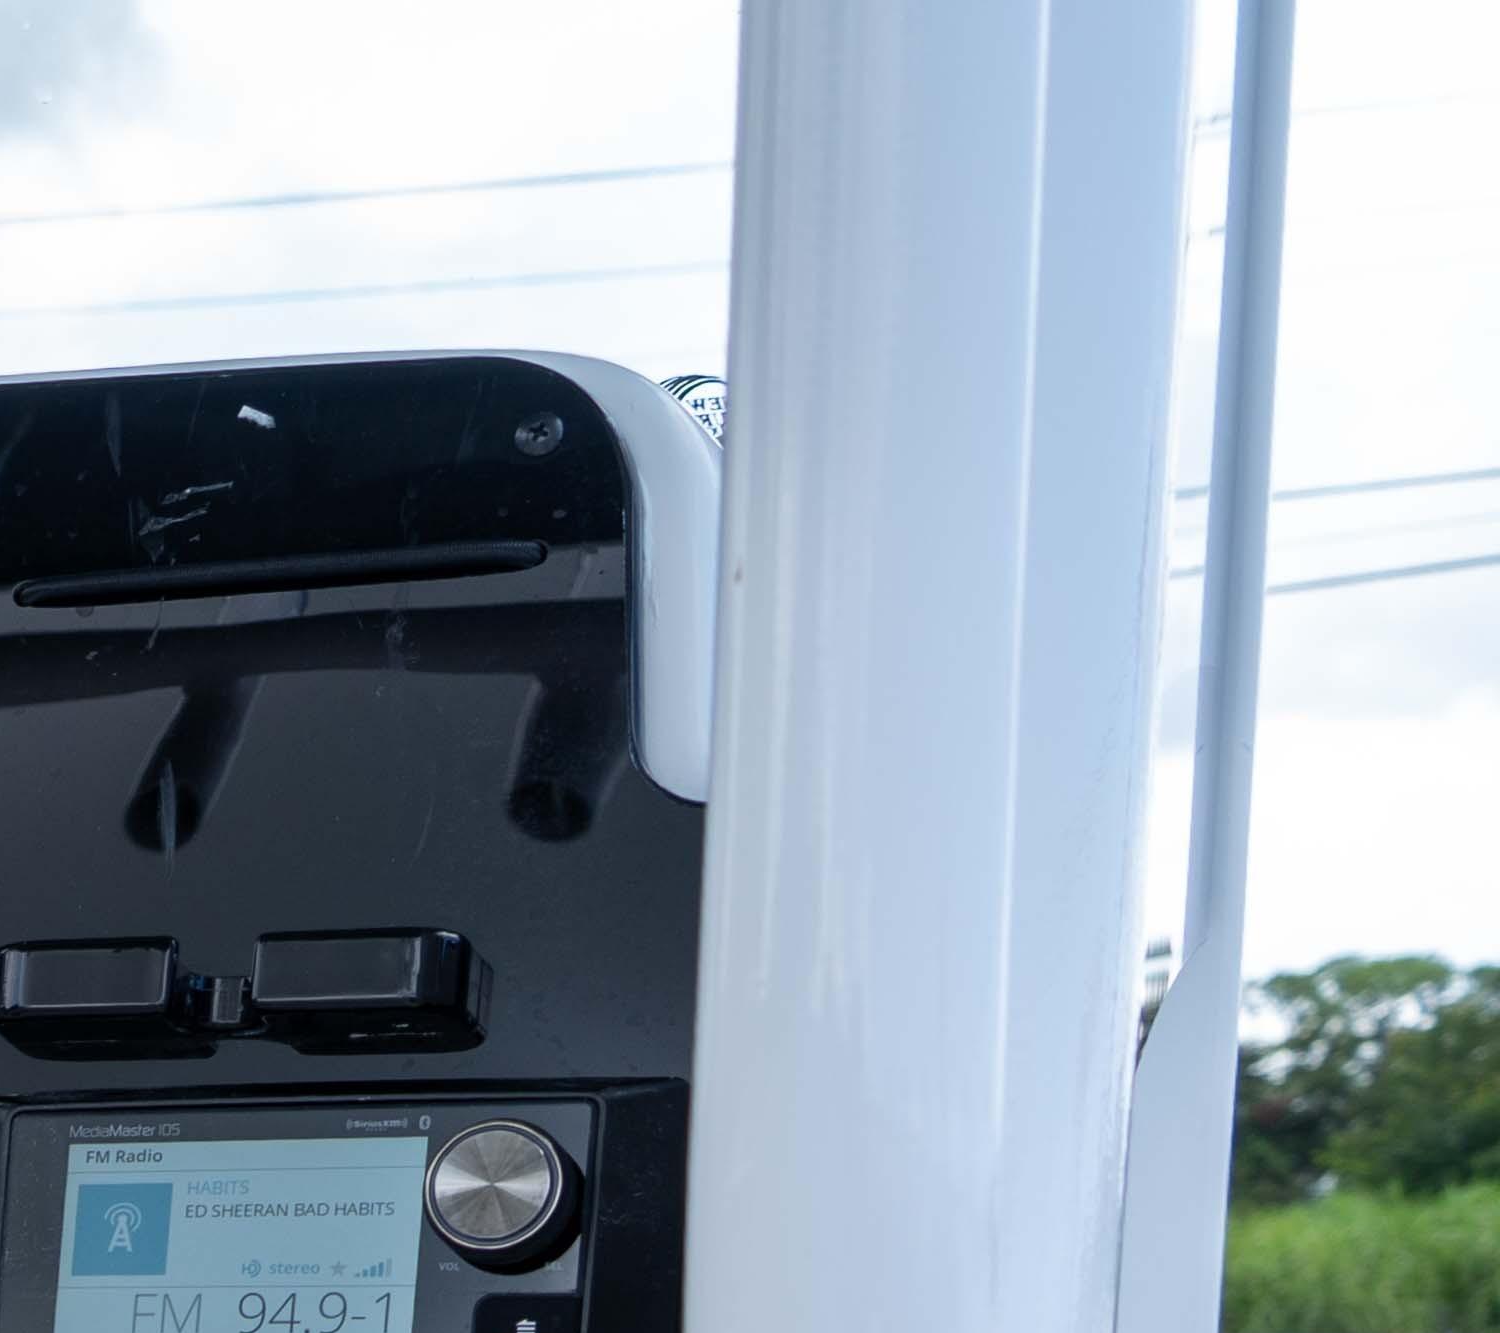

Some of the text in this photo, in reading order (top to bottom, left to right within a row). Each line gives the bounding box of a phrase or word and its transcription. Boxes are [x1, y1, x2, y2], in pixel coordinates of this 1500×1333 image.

[69, 1123, 155, 1138] MediaMaster
[85, 1149, 163, 1164] FM Radio
[187, 1179, 250, 1195] HABITS
[185, 1201, 395, 1218] ED SHEERAN BAD HABITS
[269, 1262, 320, 1275] stereo
